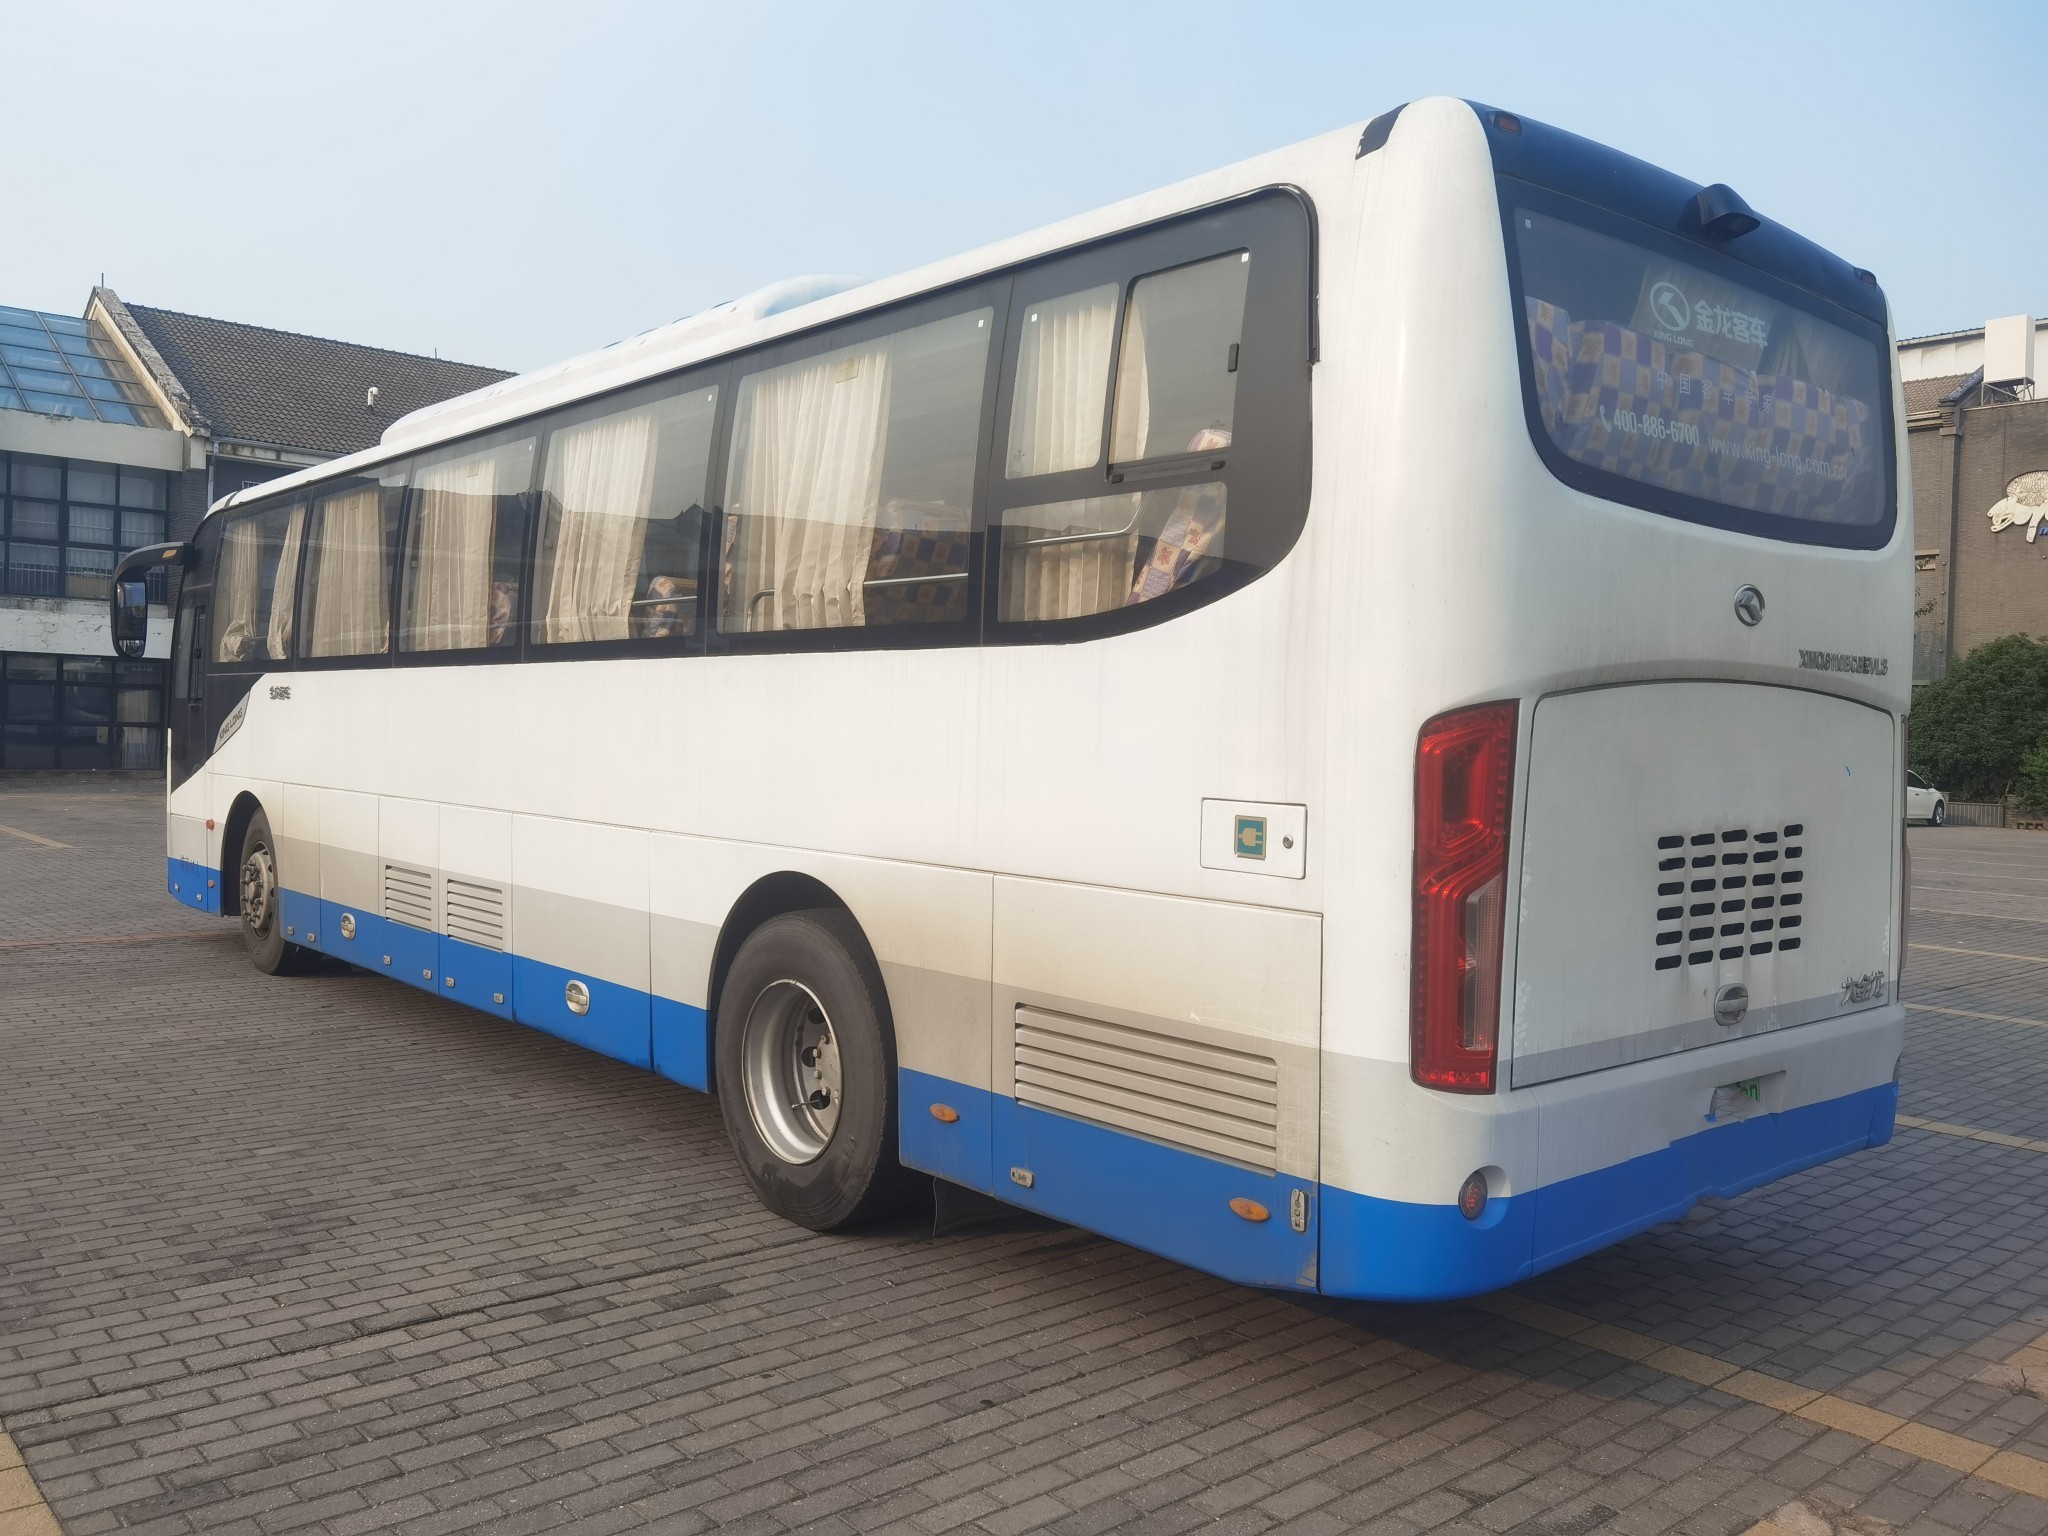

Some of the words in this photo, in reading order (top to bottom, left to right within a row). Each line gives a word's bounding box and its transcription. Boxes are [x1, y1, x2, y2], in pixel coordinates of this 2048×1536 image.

[1653, 329, 1672, 342] KING
[1673, 334, 1694, 348] LONG
[1694, 299, 1769, 349] 金龙客车
[1613, 408, 1700, 447] 400-886-6700
[1707, 437, 1849, 480] www.king-long.com.cn
[230, 707, 243, 728] LONG
[1841, 969, 1885, 1007] 大金龙
